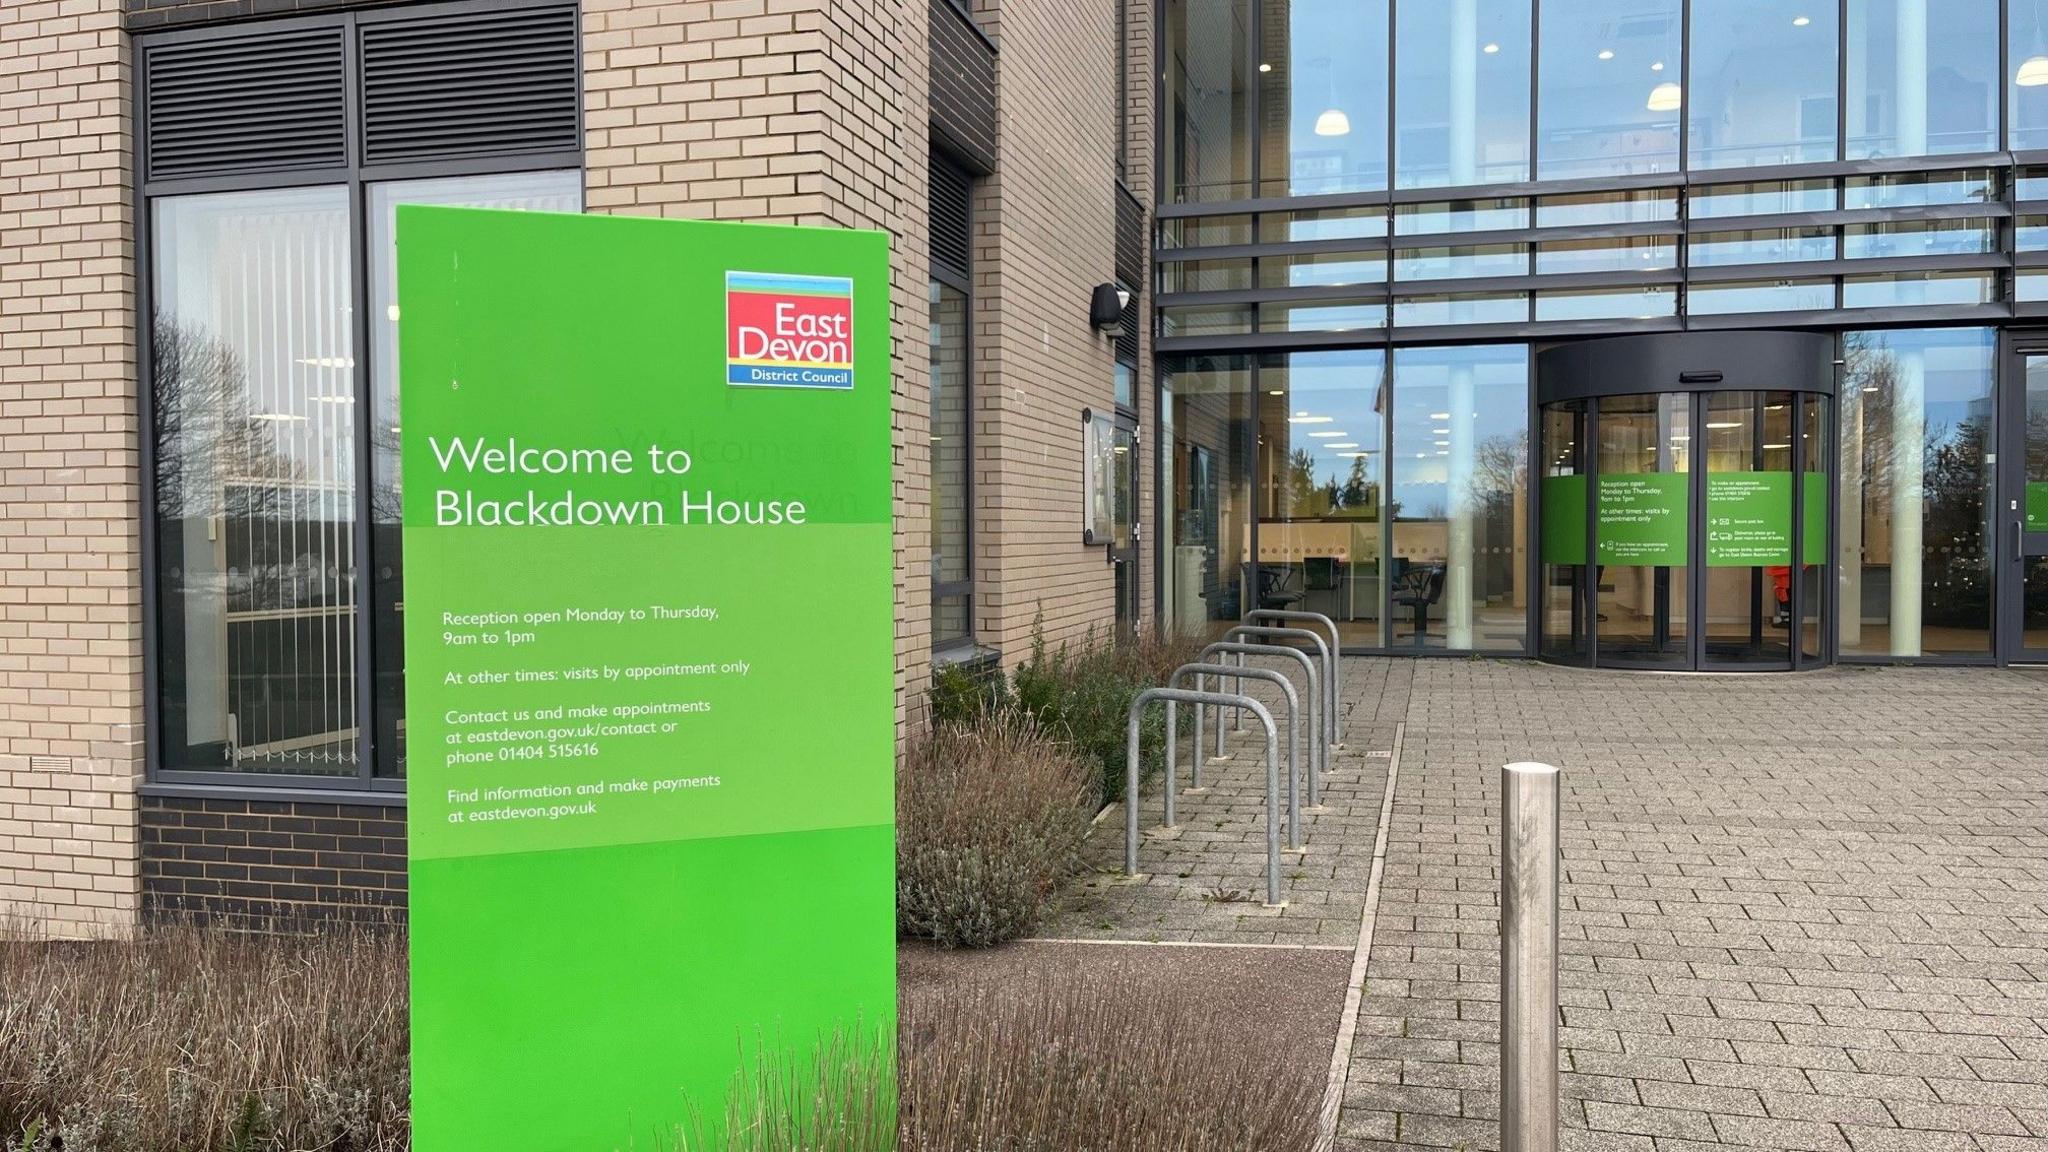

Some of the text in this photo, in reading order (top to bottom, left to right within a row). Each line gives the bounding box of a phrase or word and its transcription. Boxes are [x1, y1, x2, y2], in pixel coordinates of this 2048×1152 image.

[776, 302, 848, 338] East
[738, 326, 848, 363] Devon
[751, 369, 848, 383] District Council
[429, 437, 691, 474] Welcome to
[437, 490, 805, 527] Blackdown House
[443, 605, 718, 628] Reception open Monday to Thursday,
[443, 630, 535, 646] 9am to 1pm
[445, 660, 750, 684] At other times: visits by appointment only
[445, 701, 711, 724] Contact us and make appointments
[446, 721, 677, 744] at eastdevon.gov.uk/contact or
[447, 743, 598, 767] phone 01404 515616
[448, 776, 720, 803] Find information and make payments
[448, 801, 596, 823] at eastdevon.gov.uk
